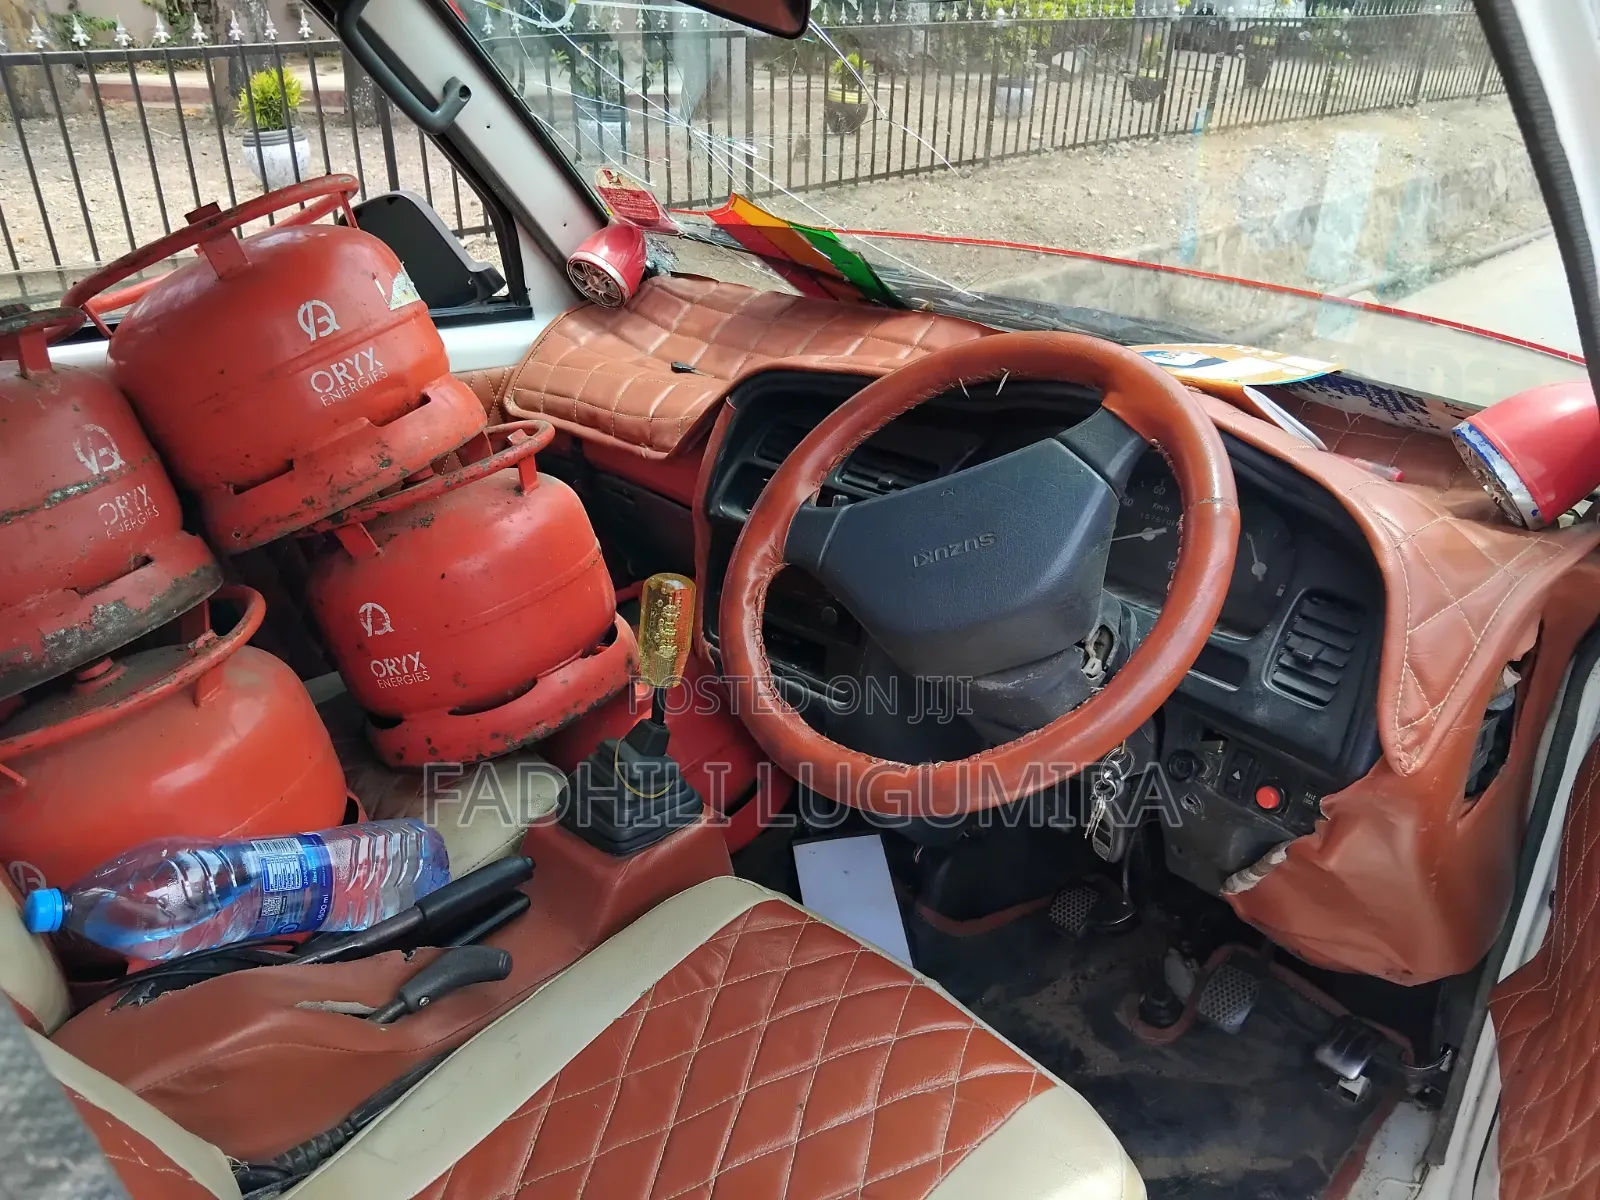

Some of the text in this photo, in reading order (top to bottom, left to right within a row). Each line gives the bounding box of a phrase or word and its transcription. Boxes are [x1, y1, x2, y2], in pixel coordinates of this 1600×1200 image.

[310, 347, 383, 393] ORYX
[320, 367, 389, 407] ENERGIES
[98, 484, 154, 526] ORYX
[1153, 484, 1166, 496] 60
[913, 532, 997, 568] SUZUKI
[370, 651, 427, 678] ORYX
[377, 670, 431, 689] ENERGIES
[322, 894, 329, 904] ml
